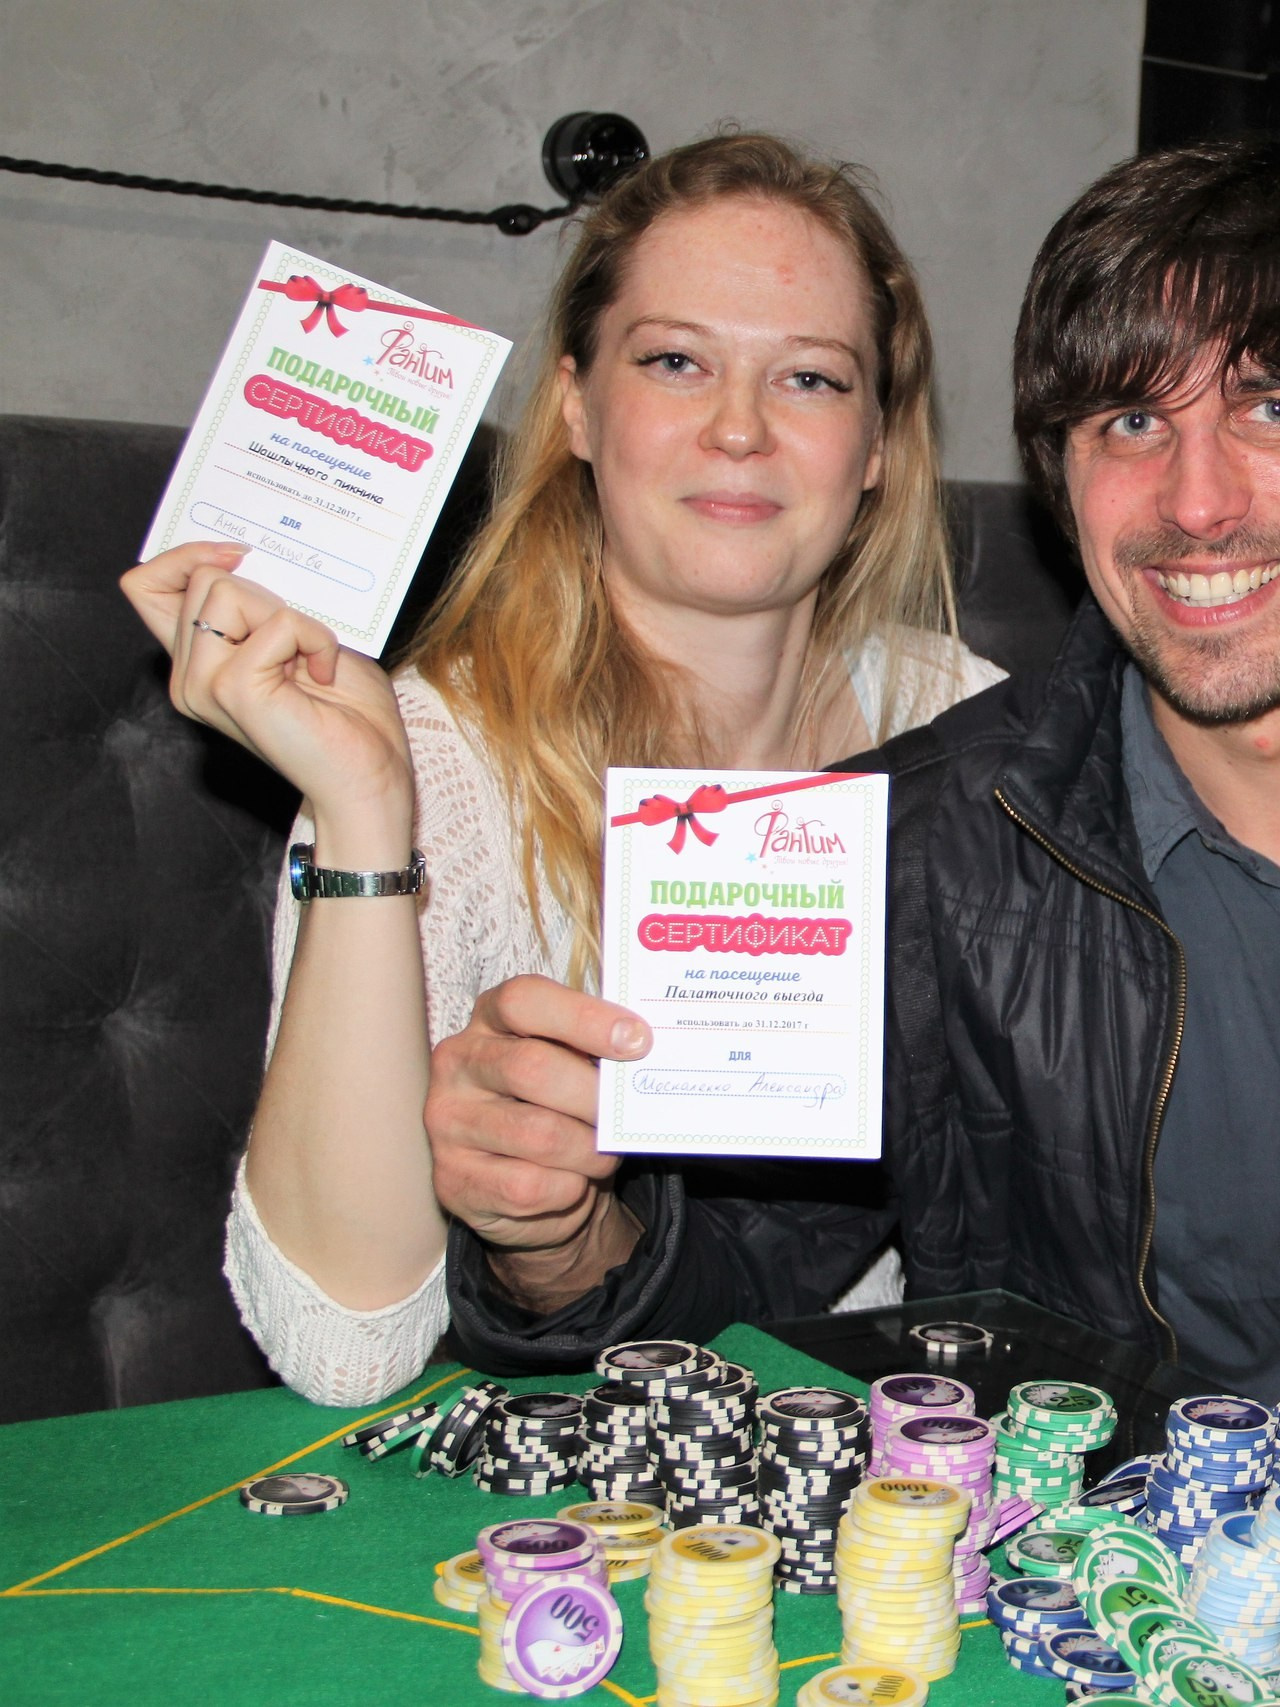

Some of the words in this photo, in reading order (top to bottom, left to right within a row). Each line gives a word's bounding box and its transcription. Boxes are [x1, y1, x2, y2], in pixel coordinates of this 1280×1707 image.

[267, 346, 441, 435] ПОДАРОЧНЫЙ
[251, 381, 427, 465] СЕРТИФИКАТ
[270, 433, 290, 446] на
[292, 441, 372, 481] посещение
[248, 441, 329, 481] Шашлычного
[334, 478, 384, 505] пикника
[246, 469, 301, 497] использовать
[302, 493, 313, 502] до
[313, 497, 356, 519] 31.12.2017
[213, 513, 247, 539] Анна
[650, 878, 846, 909] ПОДАРОЧНЫЙ
[645, 921, 846, 948] СЕРТИФИКАТ
[684, 969, 706, 980] на
[709, 969, 802, 986] посещение
[664, 985, 769, 1001] Палаточного
[773, 990, 824, 1002] выезда
[676, 1018, 740, 1028] использовать
[742, 1020, 753, 1029] до
[755, 1020, 803, 1030] 31.12.2017
[1049, 1395, 1096, 1408] 25
[880, 1482, 930, 1492] 1000
[595, 1512, 644, 1524] 1000
[550, 1593, 600, 1642] 500
